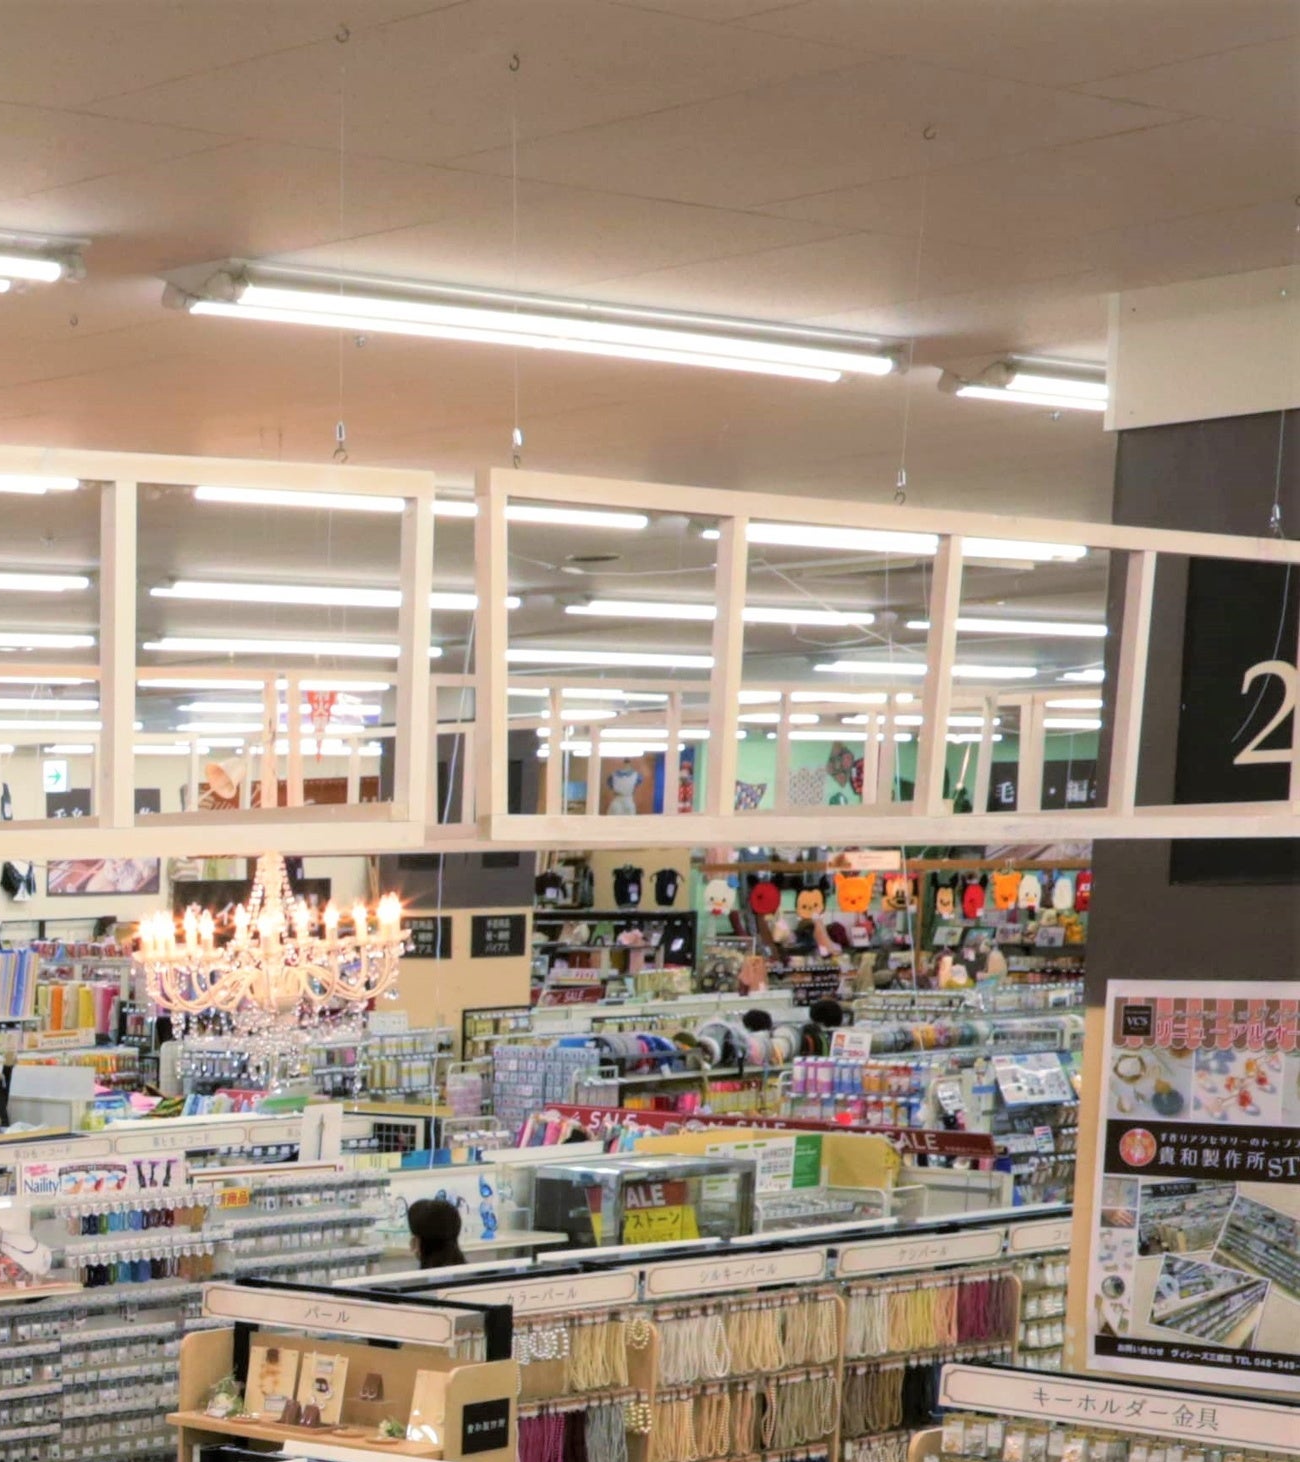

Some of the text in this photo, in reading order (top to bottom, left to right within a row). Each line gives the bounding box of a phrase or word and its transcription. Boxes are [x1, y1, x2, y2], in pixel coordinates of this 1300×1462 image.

[1232, 659, 1295, 767] 2
[24, 1178, 62, 1195] Naility!
[626, 1183, 667, 1208] ALE
[1033, 1386, 1220, 1432] キーホルダー金具
